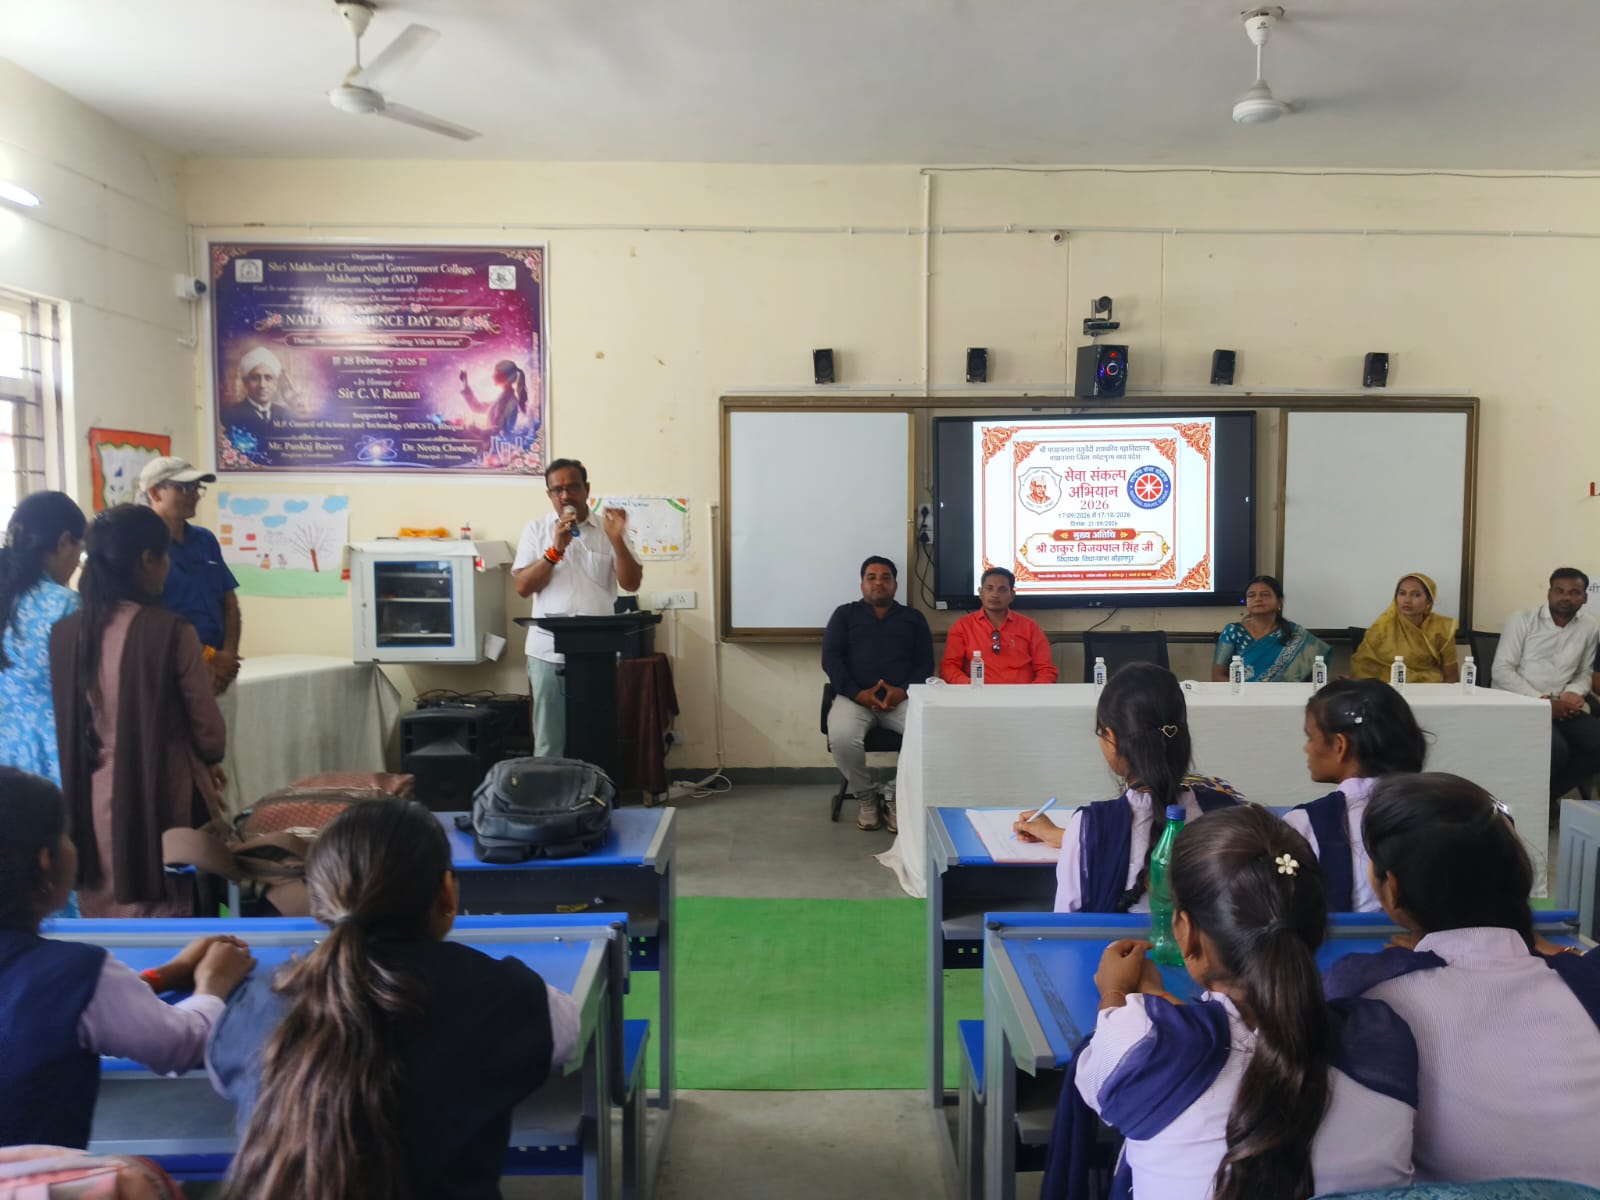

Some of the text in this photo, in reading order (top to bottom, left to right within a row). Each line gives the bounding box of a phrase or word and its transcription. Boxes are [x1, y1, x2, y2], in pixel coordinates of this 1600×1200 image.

[267, 262, 286, 272] Shri
[386, 263, 439, 274] Government
[407, 315, 432, 327] DAY
[435, 316, 460, 328] 2026
[355, 356, 393, 368] February
[396, 358, 417, 367] 2026
[337, 387, 356, 399] Sir
[383, 388, 421, 400] Raman
[1064, 466, 1087, 482] सेवा
[1089, 466, 1127, 482] संकल्प
[1068, 482, 1119, 499] अभियान
[1079, 499, 1110, 510] 2026
[1036, 540, 1153, 556] श्री ठाकुर विजयपाल सिंह जी
